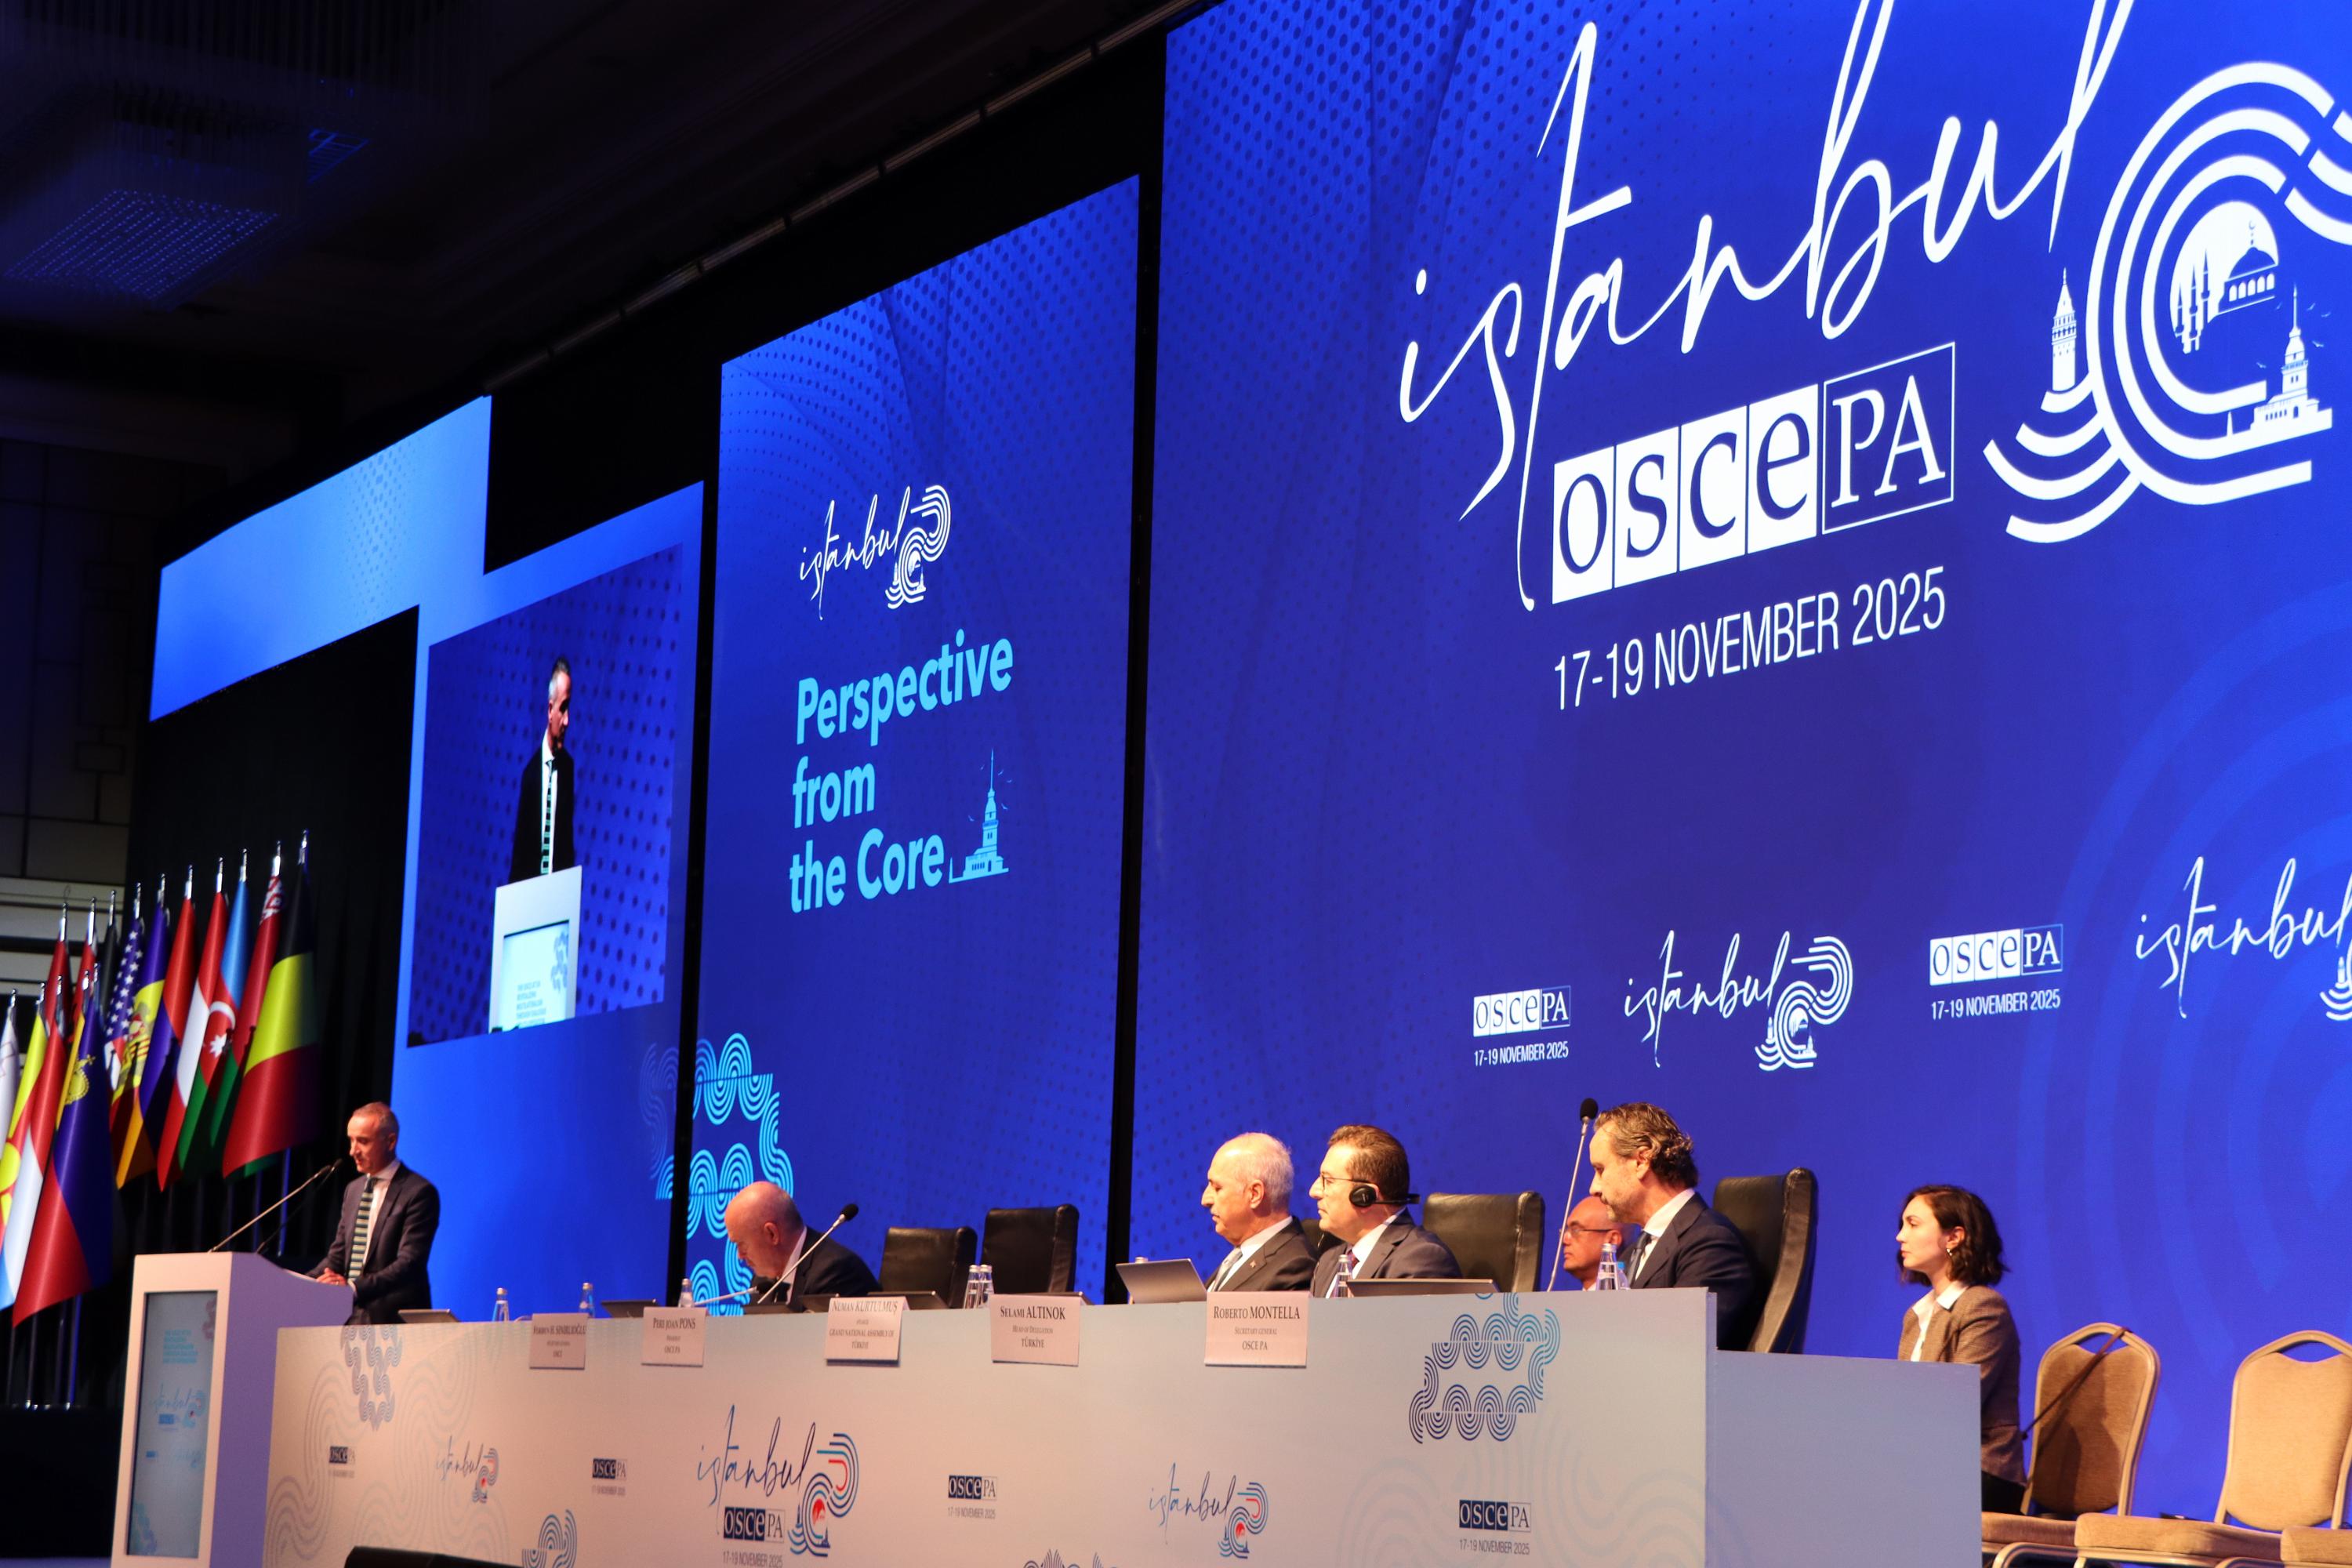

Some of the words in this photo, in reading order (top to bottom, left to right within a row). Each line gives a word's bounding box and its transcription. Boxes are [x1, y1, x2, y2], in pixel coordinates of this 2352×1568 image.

[799, 485, 911, 622] istanbul
[1554, 638, 1644, 710] 17-19
[1654, 590, 1839, 690] NOVEMBER
[1852, 565, 1946, 646] 2025
[797, 628, 1014, 747] Perspective
[792, 756, 876, 829] from
[789, 840, 847, 913] the
[857, 828, 945, 899] Core
[1624, 930, 1791, 1069] istanbul
[1931, 1000, 1964, 1020] 17-19
[1965, 993, 2028, 1017] NOVEMBER
[2029, 988, 2061, 1011] 2025
[1474, 1050, 1498, 1067] 17-19
[1500, 1044, 1545, 1065] NOVEMBER
[1546, 1040, 1569, 1060] 2025
[679, 1318, 696, 1330] PONS
[1026, 1305, 1066, 1319] ALTINOK
[1250, 1305, 1301, 1319] MONTELLA
[1242, 1341, 1258, 1351] OSCE
[1259, 1341, 1269, 1351] PA
[739, 1551, 768, 1566] NOVEMBER
[1459, 1539, 1478, 1552] 17-19
[1479, 1540, 1512, 1555] NOVEMBER
[1513, 1541, 1531, 1555] 2025
